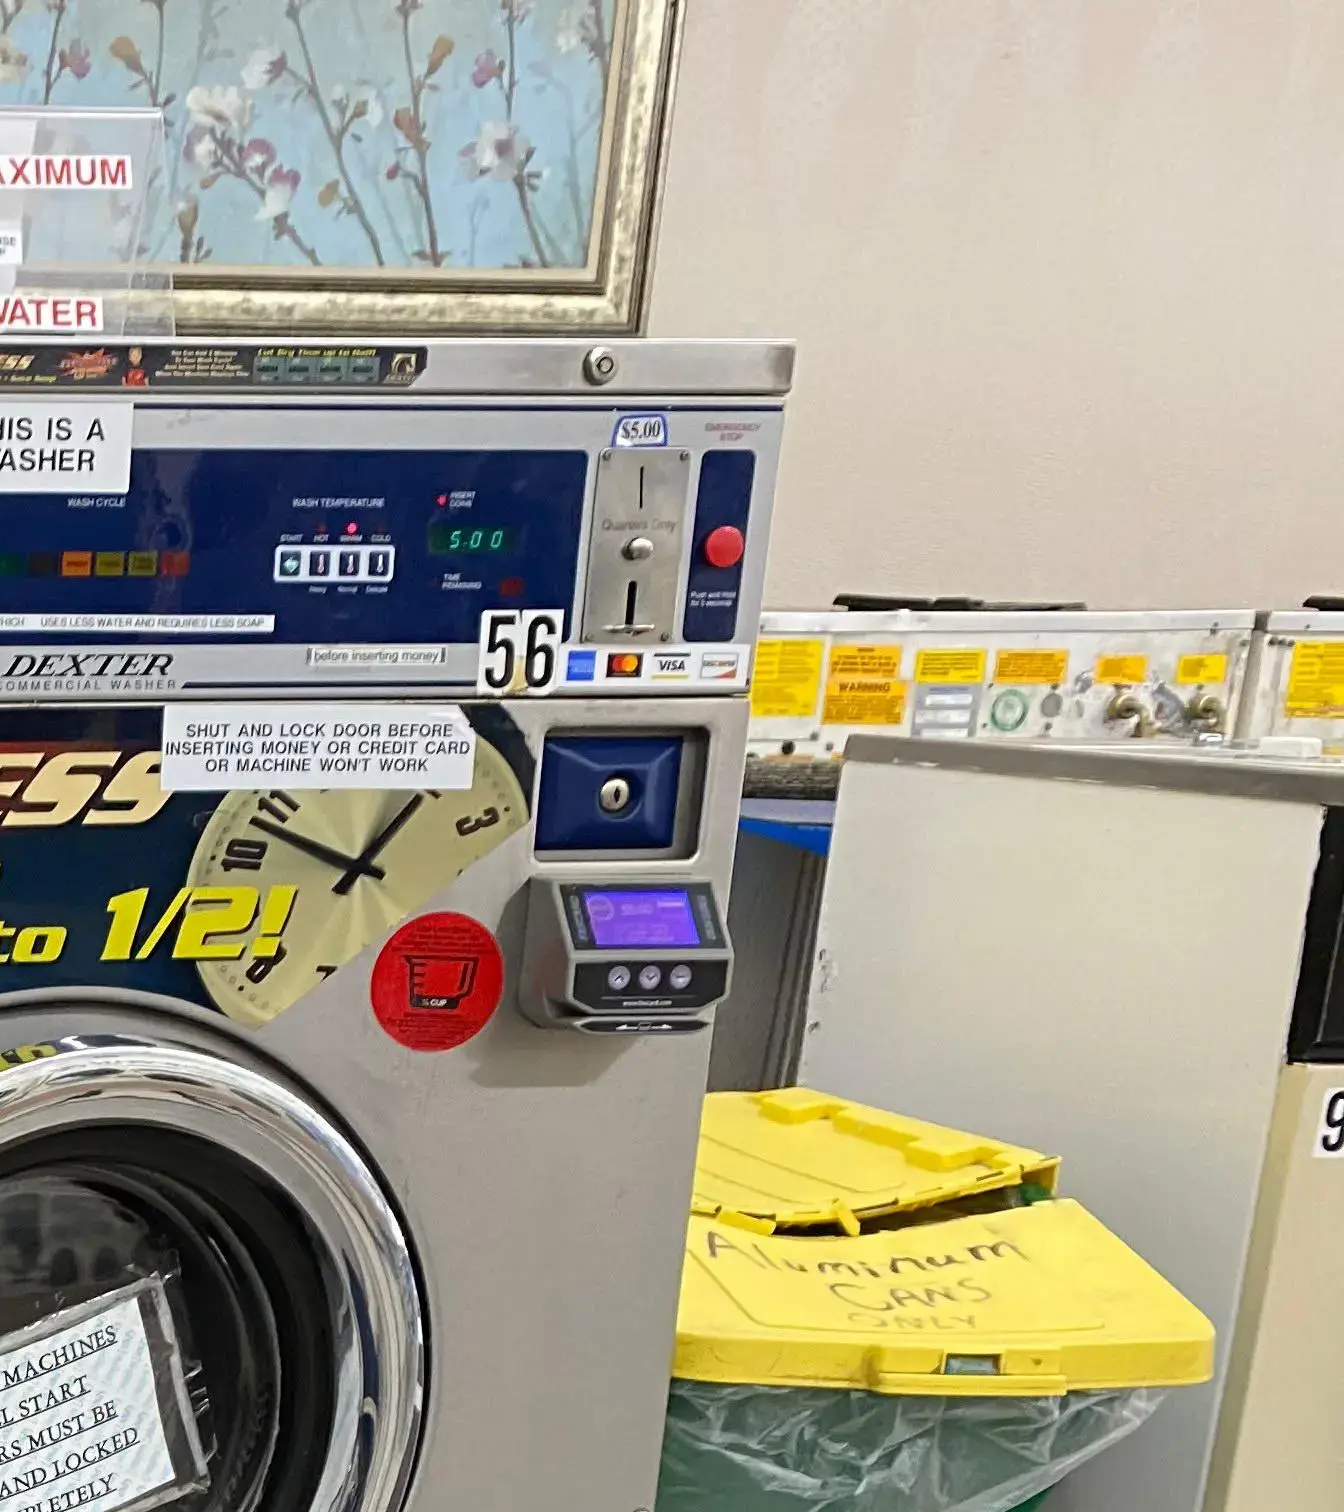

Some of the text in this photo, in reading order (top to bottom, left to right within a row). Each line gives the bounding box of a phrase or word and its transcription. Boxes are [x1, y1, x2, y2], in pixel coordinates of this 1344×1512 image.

[47, 417, 73, 442] IS
[86, 418, 105, 442] A
[621, 420, 662, 440] $5.00
[0, 653, 174, 679] DEXTER
[484, 614, 557, 690] 56
[110, 679, 177, 690] WASHER
[165, 740, 471, 756] INSERTING MONEY OR CREDIT CARD
[186, 723, 453, 738] SHUT AND LOCK DOOR BEFORE
[205, 757, 429, 773] OR MACHINE WON'T WORK
[100, 884, 299, 962] 1/2!
[707, 1230, 1031, 1277] Aluminum
[829, 1277, 992, 1313] CANS
[2, 1325, 118, 1387] MACHINES
[18, 1374, 91, 1416] START
[27, 1412, 88, 1453] MUST
[92, 1400, 118, 1427] BE
[0, 1466, 48, 1501] AND
[52, 1426, 140, 1477] LOCKED
